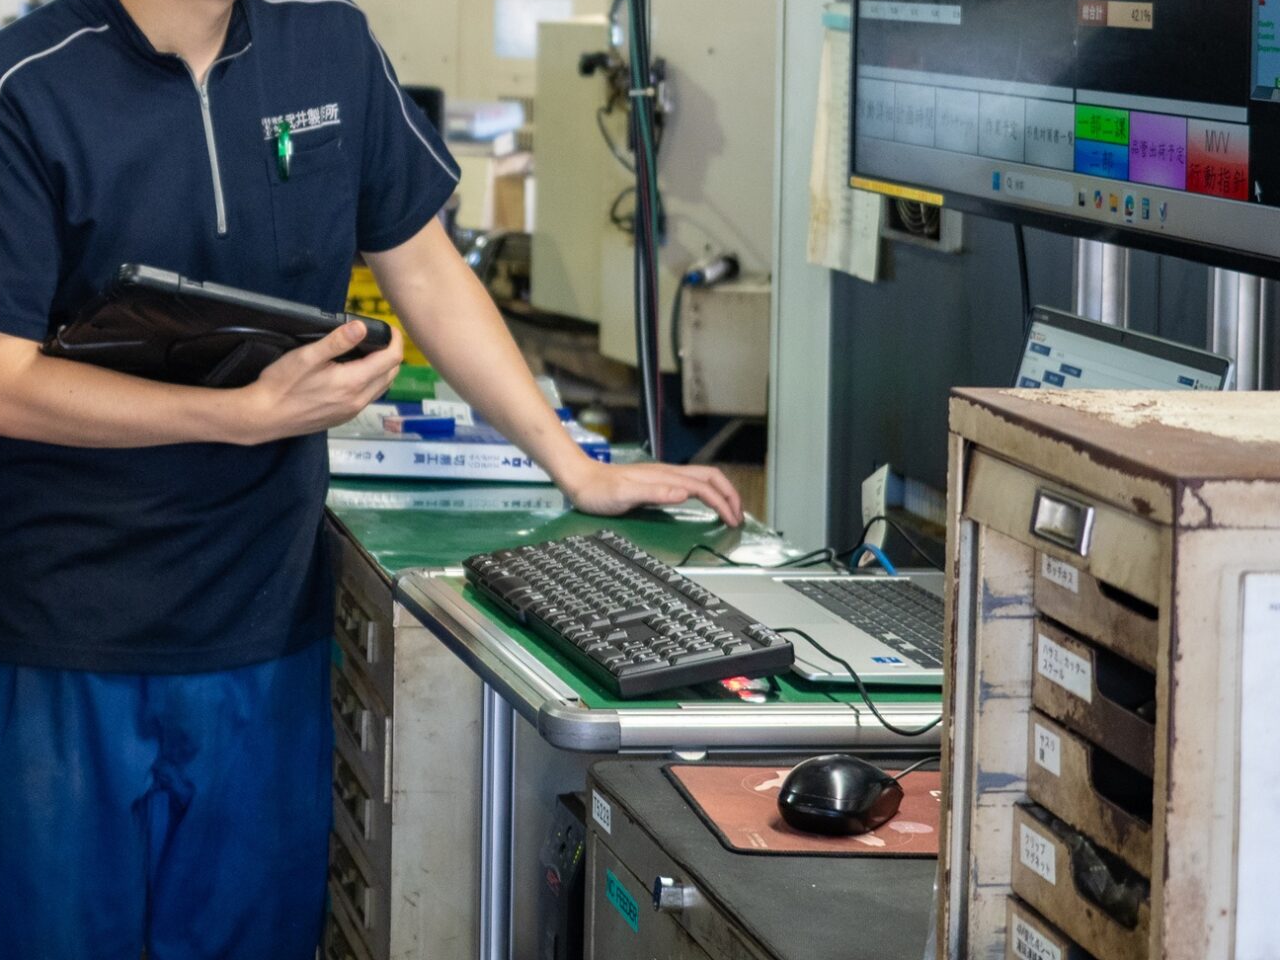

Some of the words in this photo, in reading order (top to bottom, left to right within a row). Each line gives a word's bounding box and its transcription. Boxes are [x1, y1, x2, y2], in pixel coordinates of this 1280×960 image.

[1077, 114, 1126, 140] 一部二課
[1205, 129, 1230, 154] MVV
[1089, 150, 1113, 171] 二部
[1189, 163, 1247, 194] 行動指針
[414, 452, 465, 467] 切削工具
[1046, 562, 1073, 585] ホッチキス
